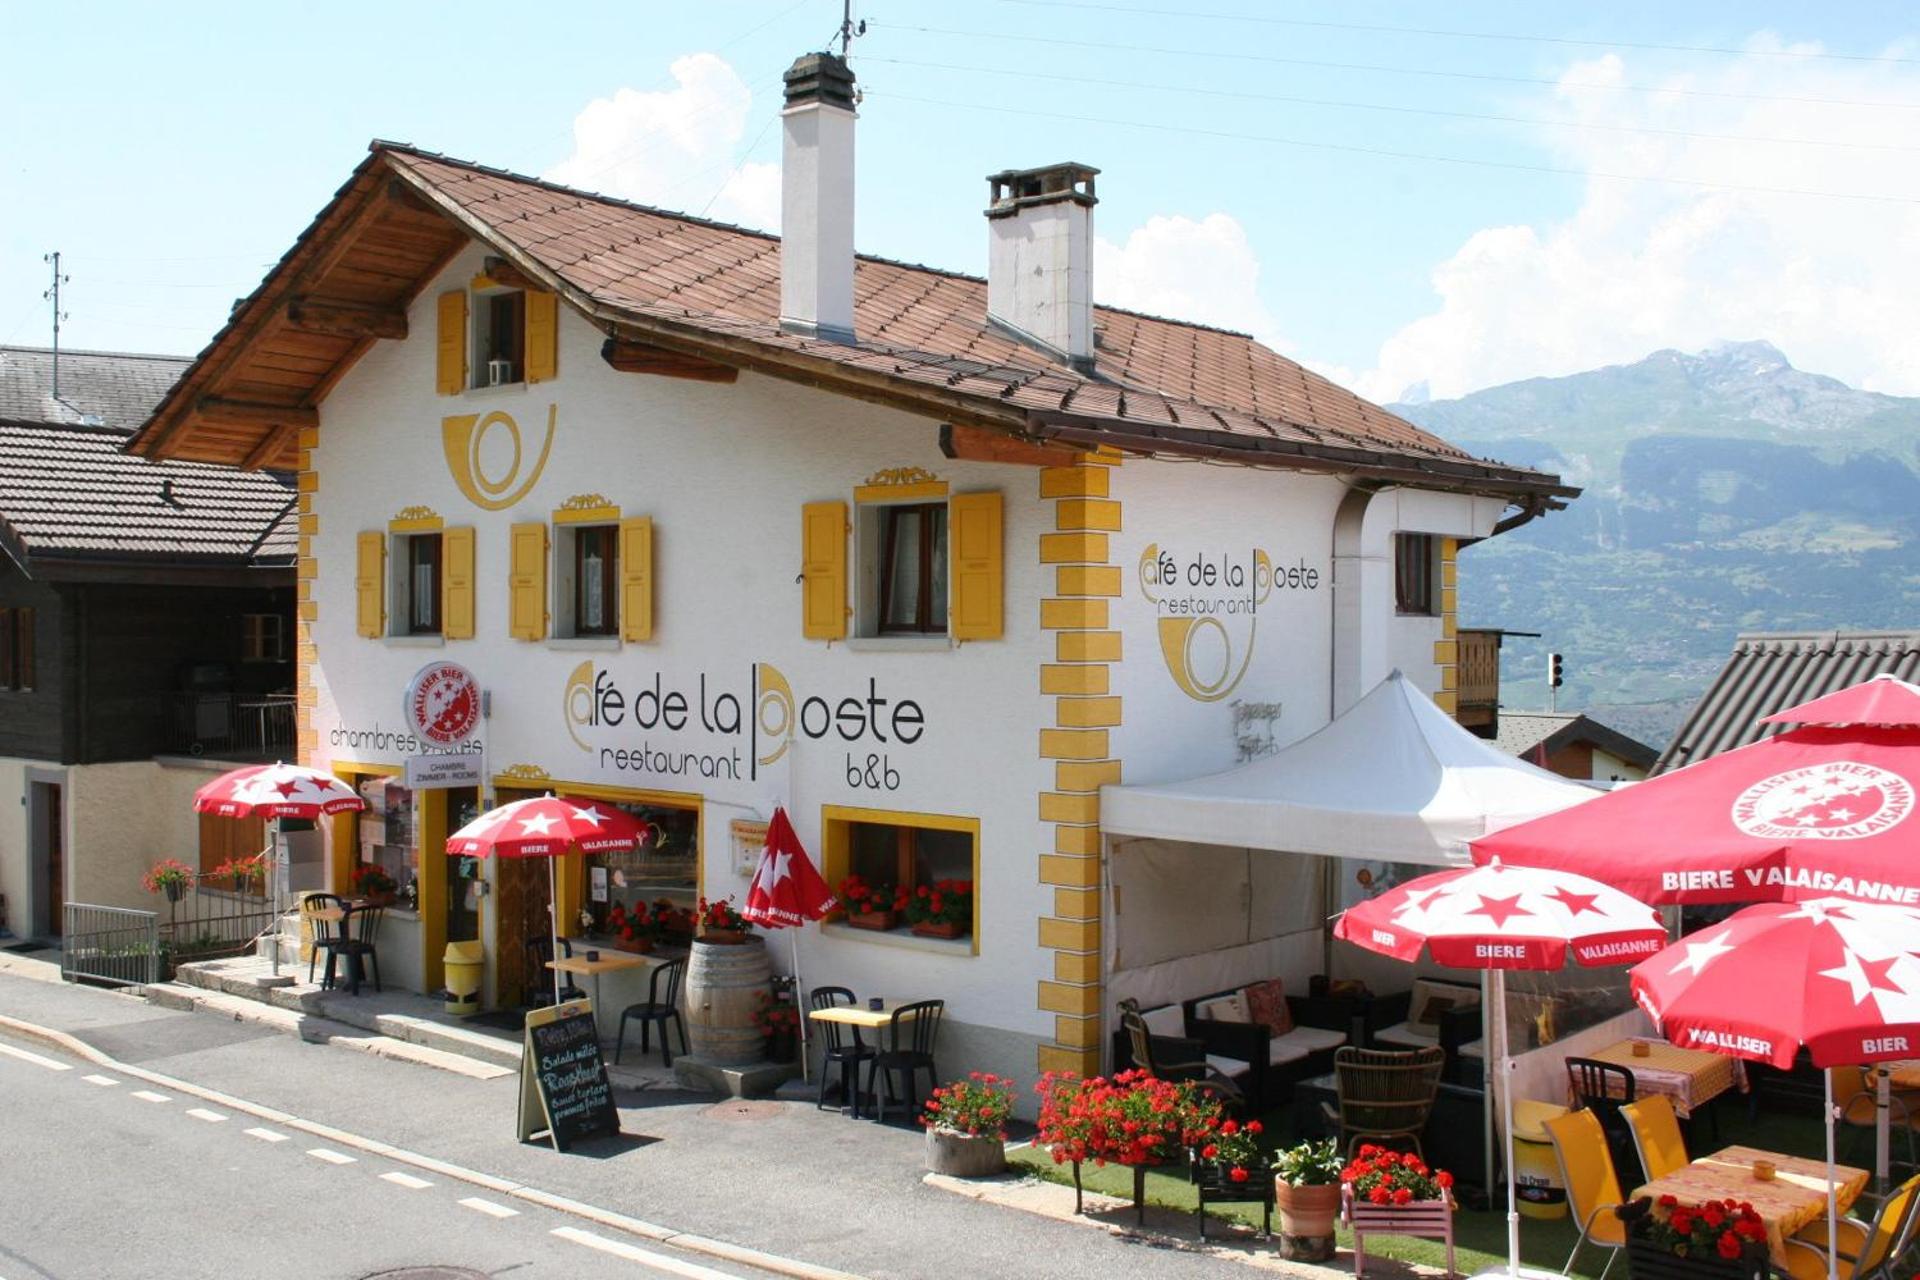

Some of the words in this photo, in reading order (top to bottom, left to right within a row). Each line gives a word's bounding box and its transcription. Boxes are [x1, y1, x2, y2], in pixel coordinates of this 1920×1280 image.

[1187, 552, 1217, 586] de
[1224, 552, 1244, 587] la
[1157, 594, 1252, 615] restaurant
[440, 668, 464, 681] BIER
[414, 672, 440, 728] WALLISER
[634, 672, 688, 731] de
[700, 673, 741, 735] la
[330, 722, 417, 752] chambres
[600, 741, 742, 781] restaurant
[846, 752, 900, 791] b&b
[1823, 764, 1883, 780] BIER
[1736, 769, 1815, 824] WALLISER
[1816, 778, 1910, 838] VALAISANNE
[1748, 823, 1811, 838] BIERE
[1662, 870, 1735, 891] BIERE
[1744, 866, 1920, 904] VALAISANNE
[1475, 944, 1526, 959] BIERE
[1579, 939, 1660, 960] VALAISANNE
[1687, 1027, 1773, 1056] WALLISER
[1862, 1036, 1909, 1054] BIER
